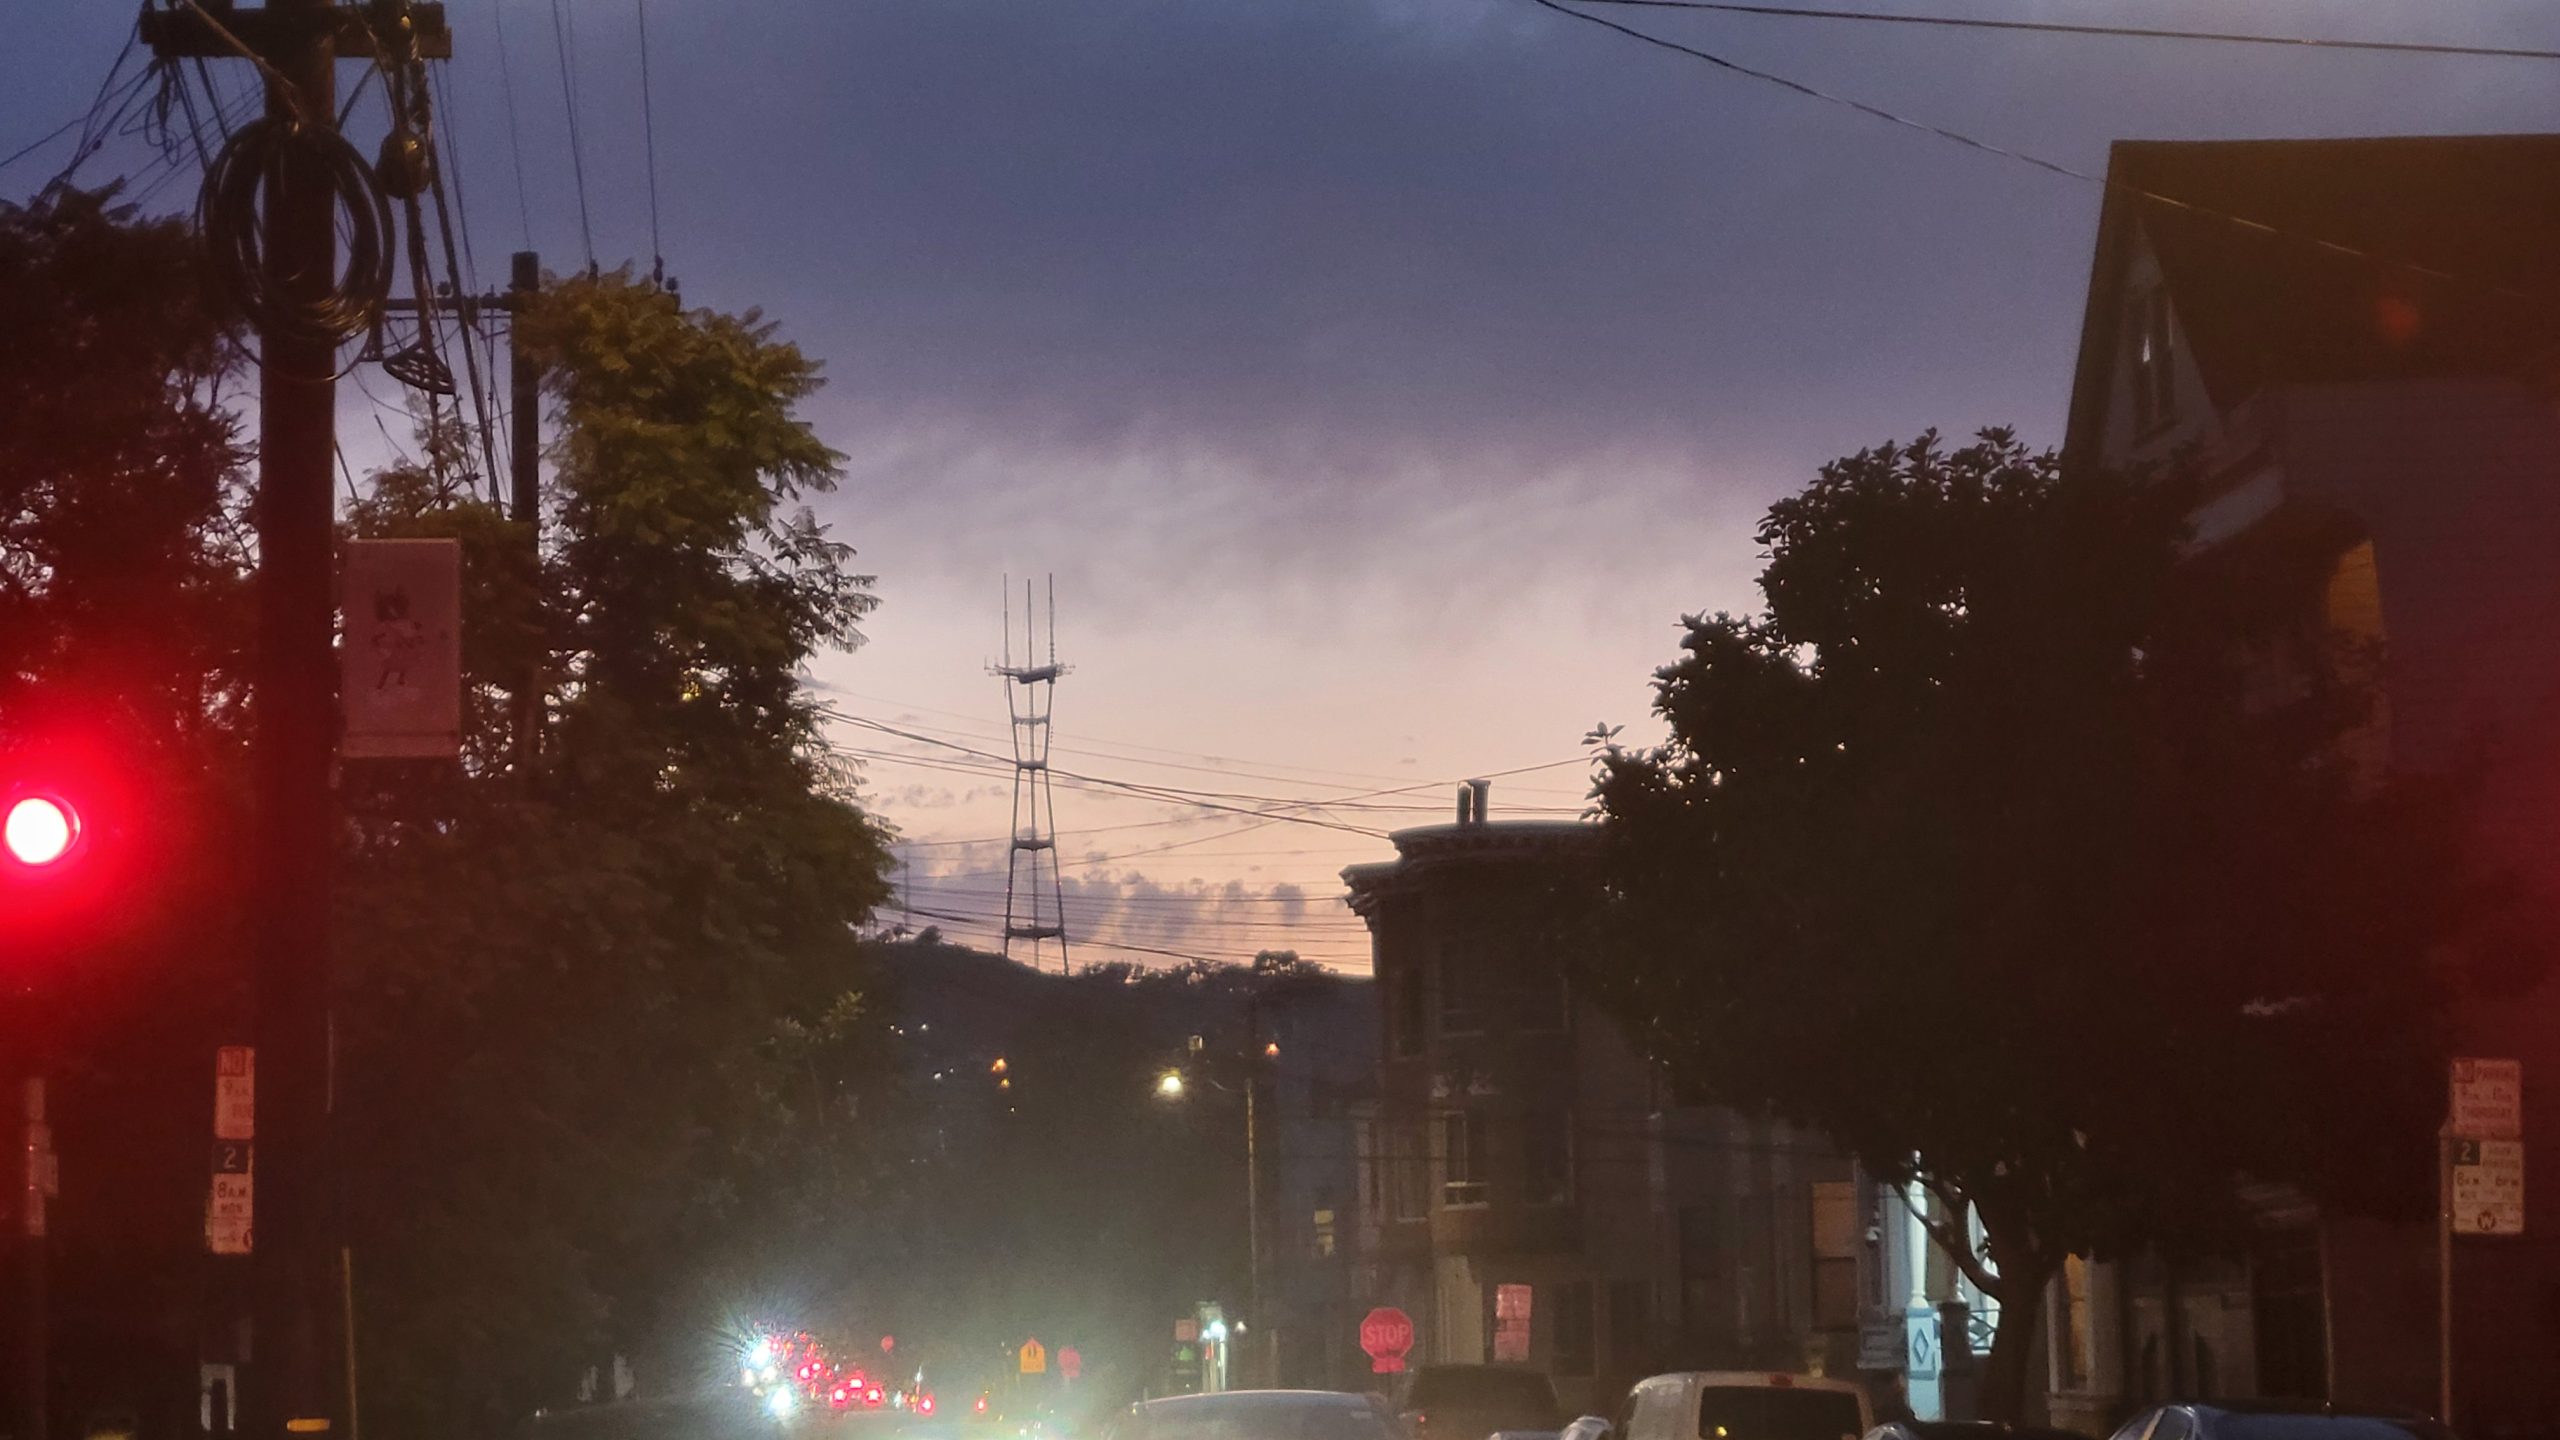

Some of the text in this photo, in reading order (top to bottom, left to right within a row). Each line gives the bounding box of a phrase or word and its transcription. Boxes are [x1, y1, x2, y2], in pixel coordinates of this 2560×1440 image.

[224, 1147, 236, 1169] 2
[2460, 1142, 2471, 1161] 2
[1366, 1324, 1410, 1345] STOP
